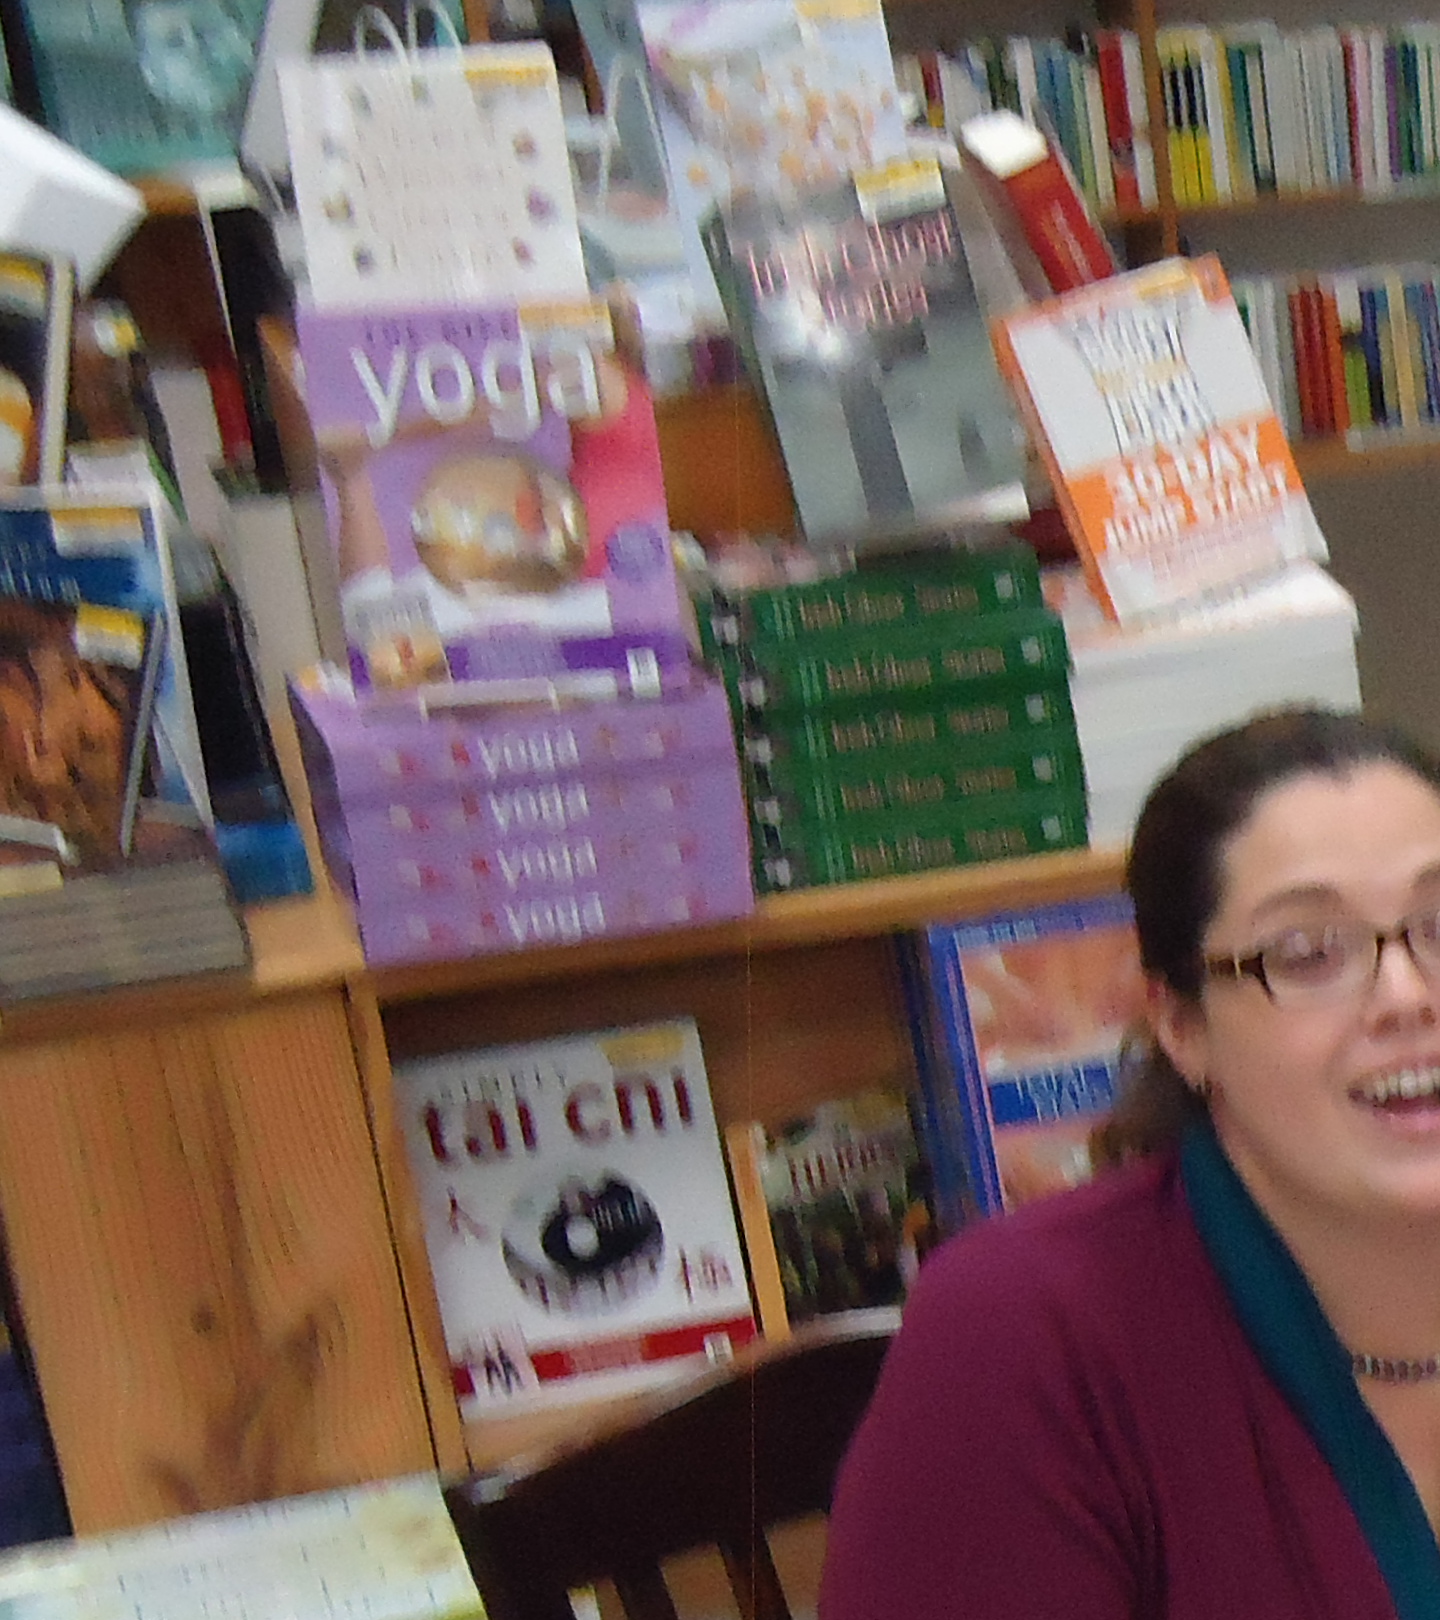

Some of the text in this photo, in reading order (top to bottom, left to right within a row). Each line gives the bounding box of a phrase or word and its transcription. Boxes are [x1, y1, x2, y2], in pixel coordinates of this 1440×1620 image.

[351, 342, 604, 449] yoga
[477, 726, 580, 781] yoga
[489, 781, 591, 835] yoga
[498, 836, 599, 892] yoga
[503, 890, 607, 946] yoga
[422, 1092, 539, 1167] tai
